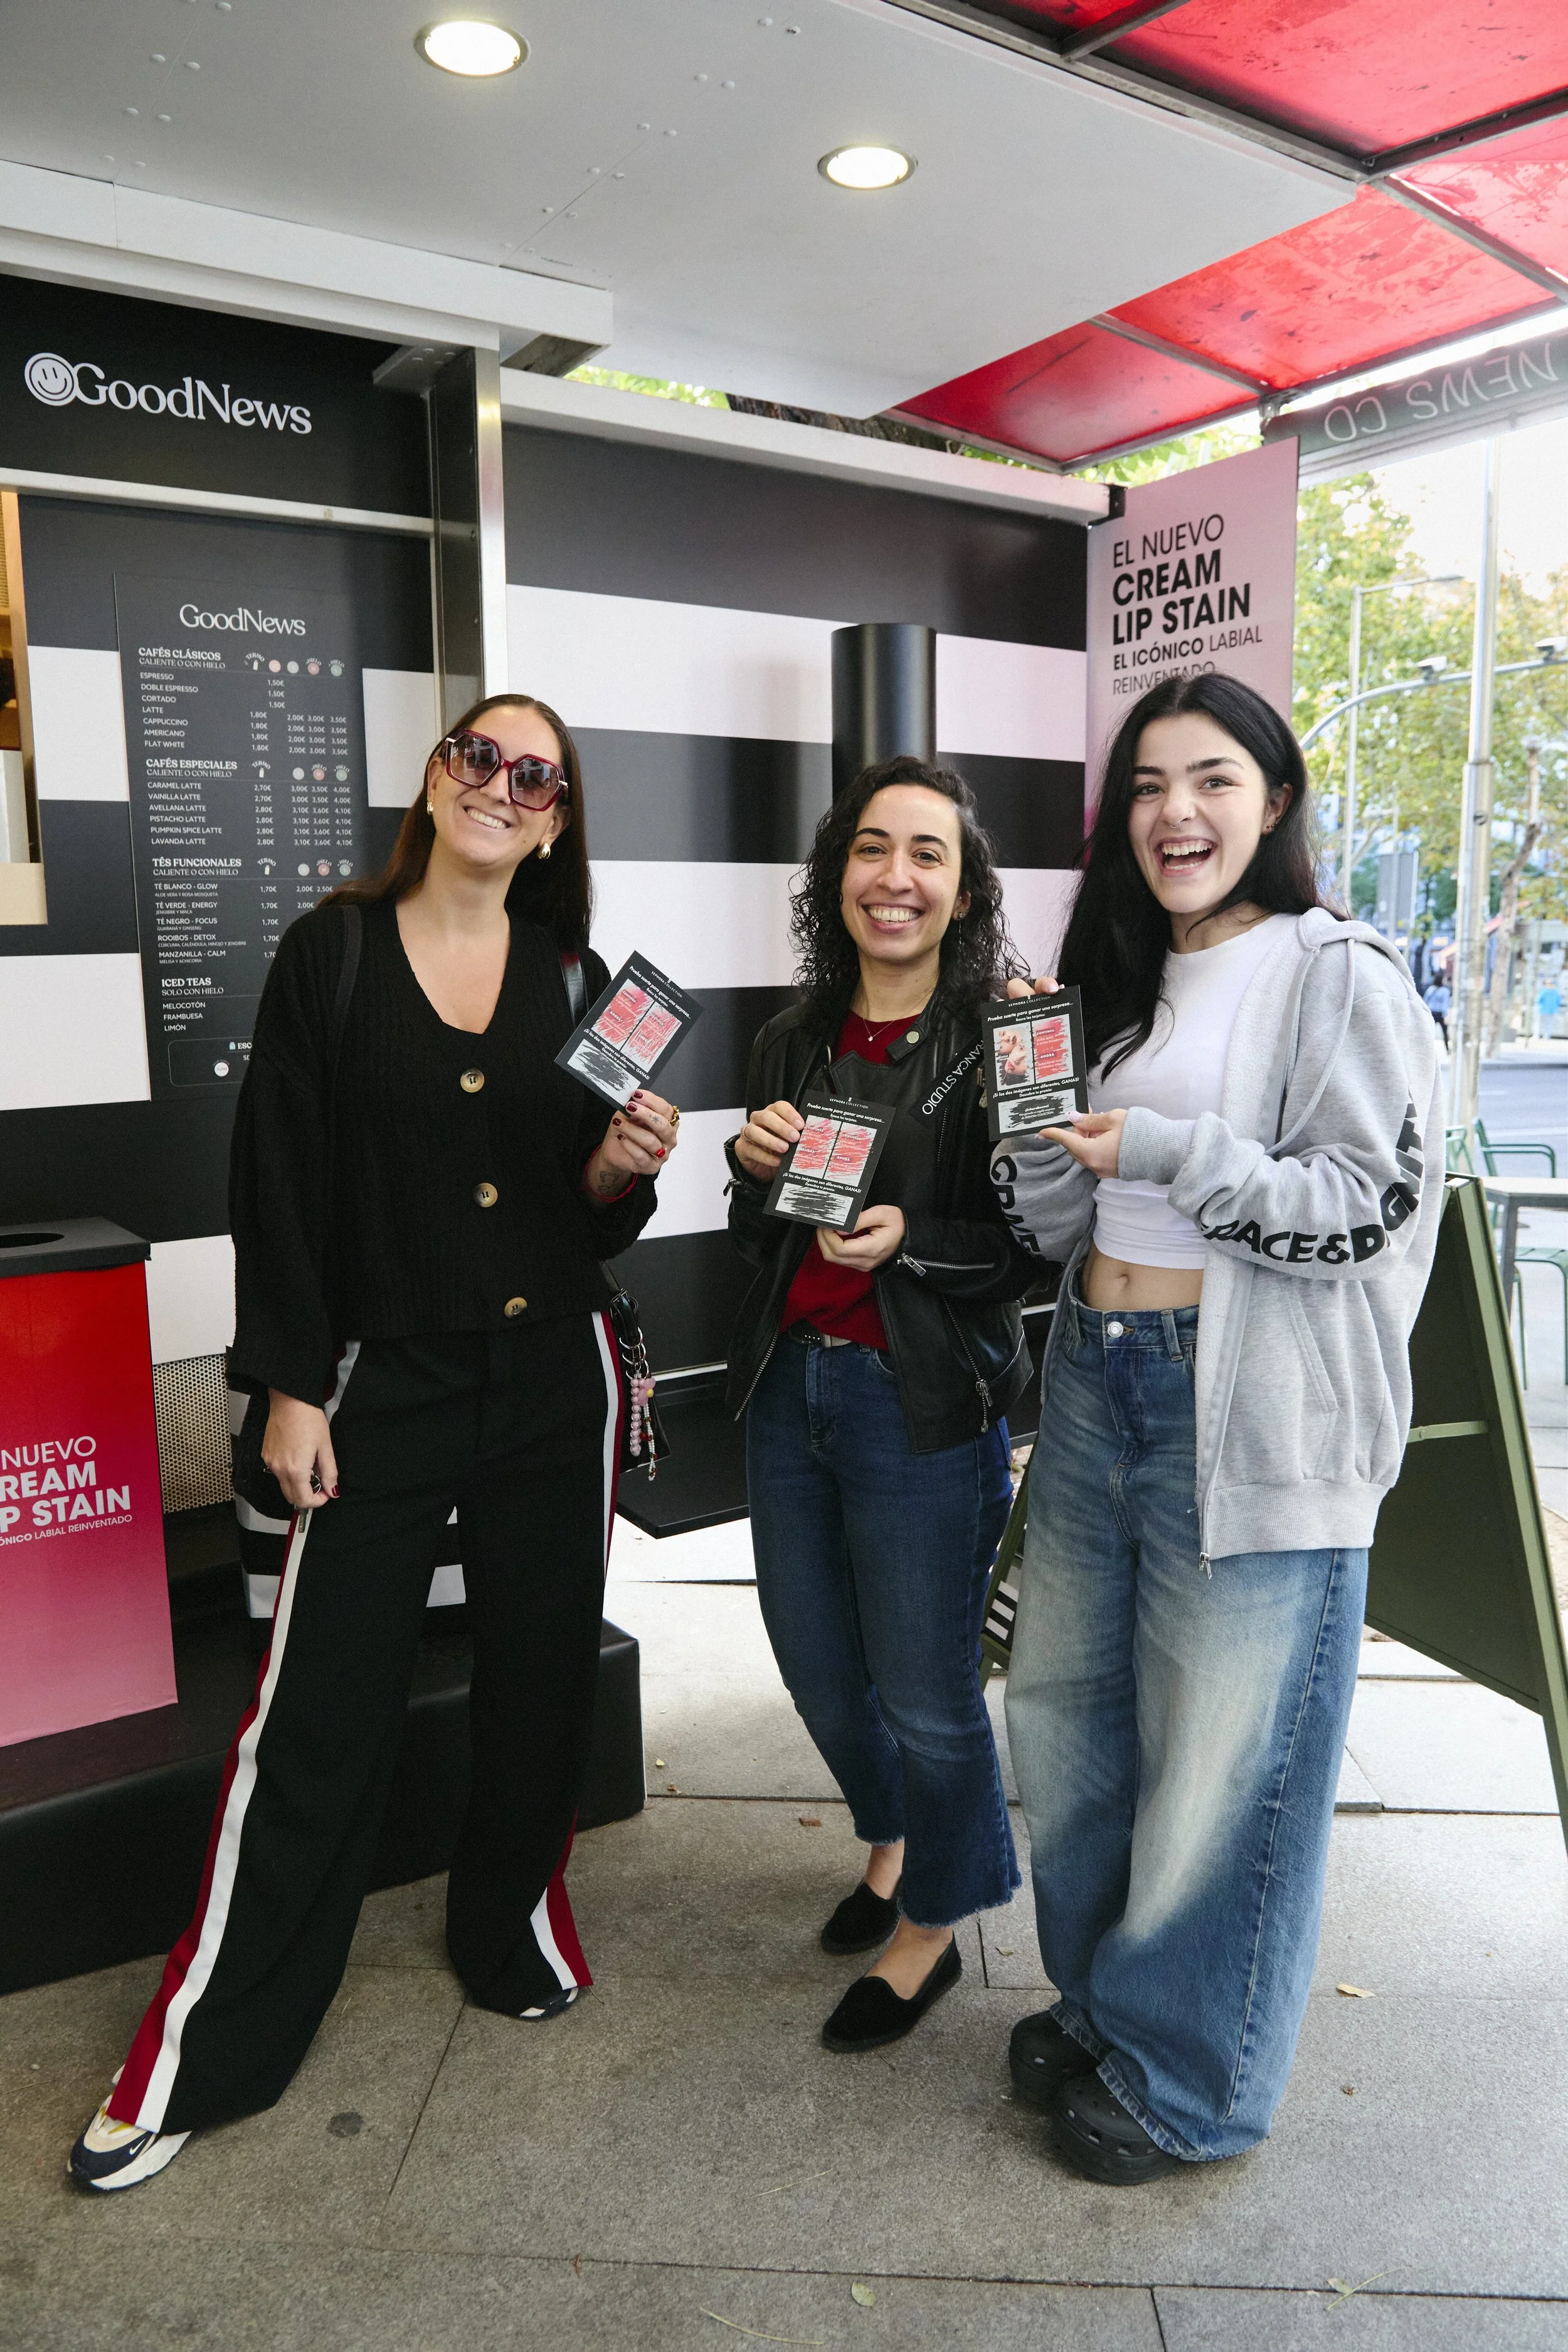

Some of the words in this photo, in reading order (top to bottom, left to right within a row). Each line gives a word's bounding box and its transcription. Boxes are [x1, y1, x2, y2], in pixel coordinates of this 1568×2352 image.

[72, 362, 312, 434] GoodNews
[1113, 541, 1134, 568] EL
[1142, 514, 1224, 560] NUEVO
[1113, 549, 1221, 606] CREAM
[179, 603, 306, 635] GoodNews
[1113, 607, 1152, 645] LIP
[1163, 583, 1251, 634] STAIN
[139, 647, 171, 657] CAFÉS
[172, 649, 221, 660] CLÁSICOS
[139, 658, 176, 666] CALIENTE
[1113, 654, 1127, 670] EL
[1133, 642, 1204, 667] ICÓNICO
[1210, 625, 1263, 652] LABIAL
[146, 758, 177, 768] CAFÉS
[180, 760, 237, 770] ESPECIALES
[152, 857, 171, 867] TÉS
[173, 858, 241, 867] FUNCIONALES
[162, 978, 184, 987] ICED
[186, 977, 211, 986] TEAS
[163, 1001, 206, 1009] MELOCOTÓN
[922, 1074, 957, 1115] STUDIO
[1, 1436, 97, 1470] NUEVO
[32, 1485, 131, 1527] STAIN
[34, 1527, 66, 1540] LABIAL
[68, 1515, 132, 1533] REINVENTADO
